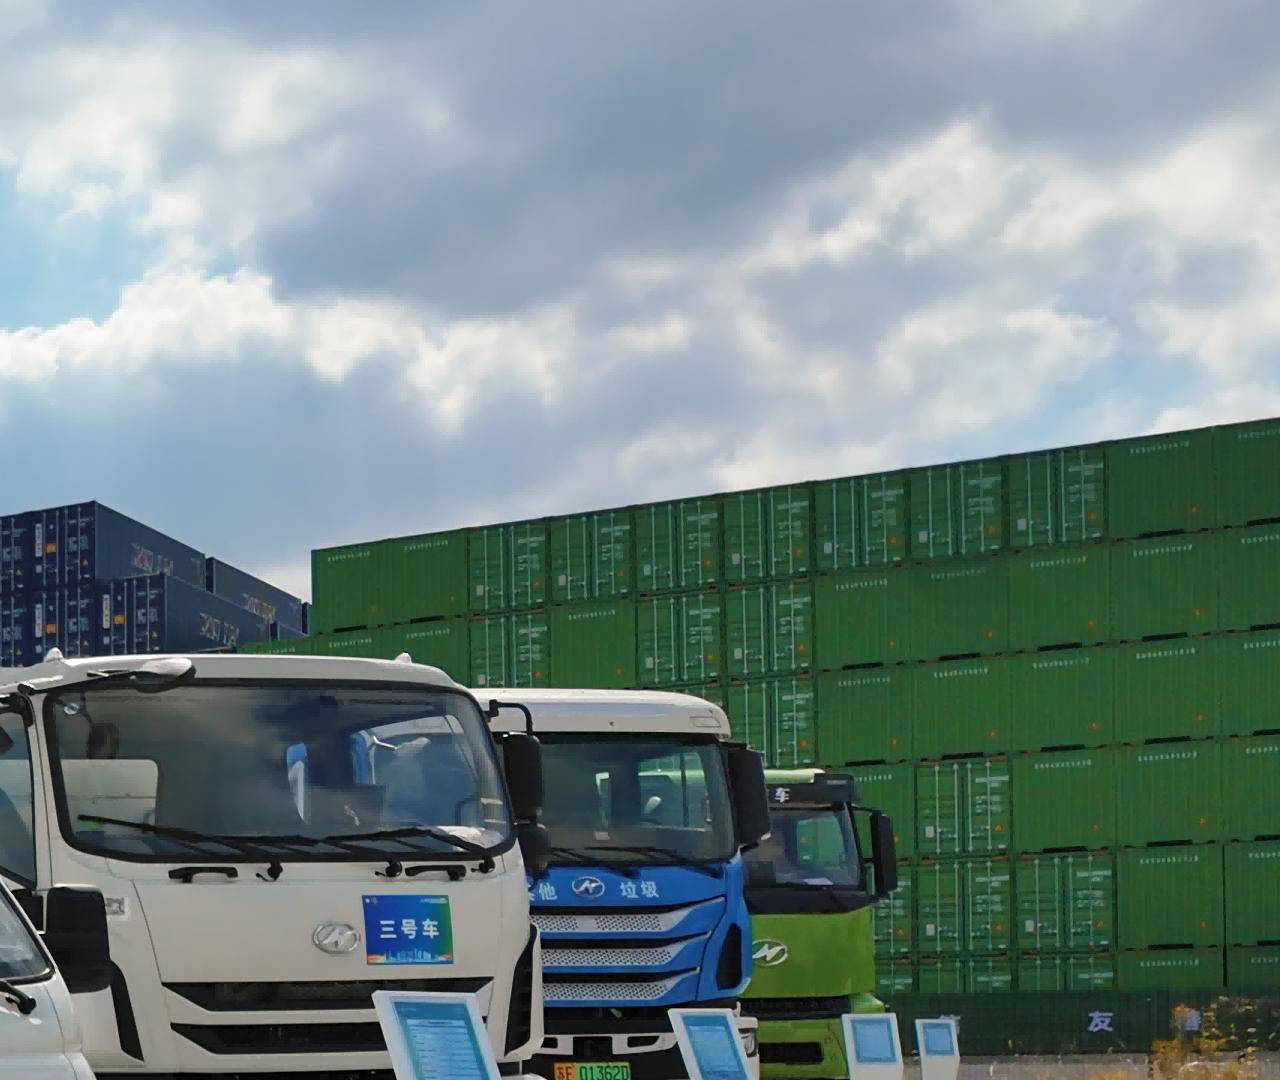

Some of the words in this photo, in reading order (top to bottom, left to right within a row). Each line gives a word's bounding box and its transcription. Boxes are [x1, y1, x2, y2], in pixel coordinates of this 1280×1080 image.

[620, 880, 660, 899] 垃圾
[379, 918, 440, 940] 三号车
[1087, 1010, 1114, 1032] 友
